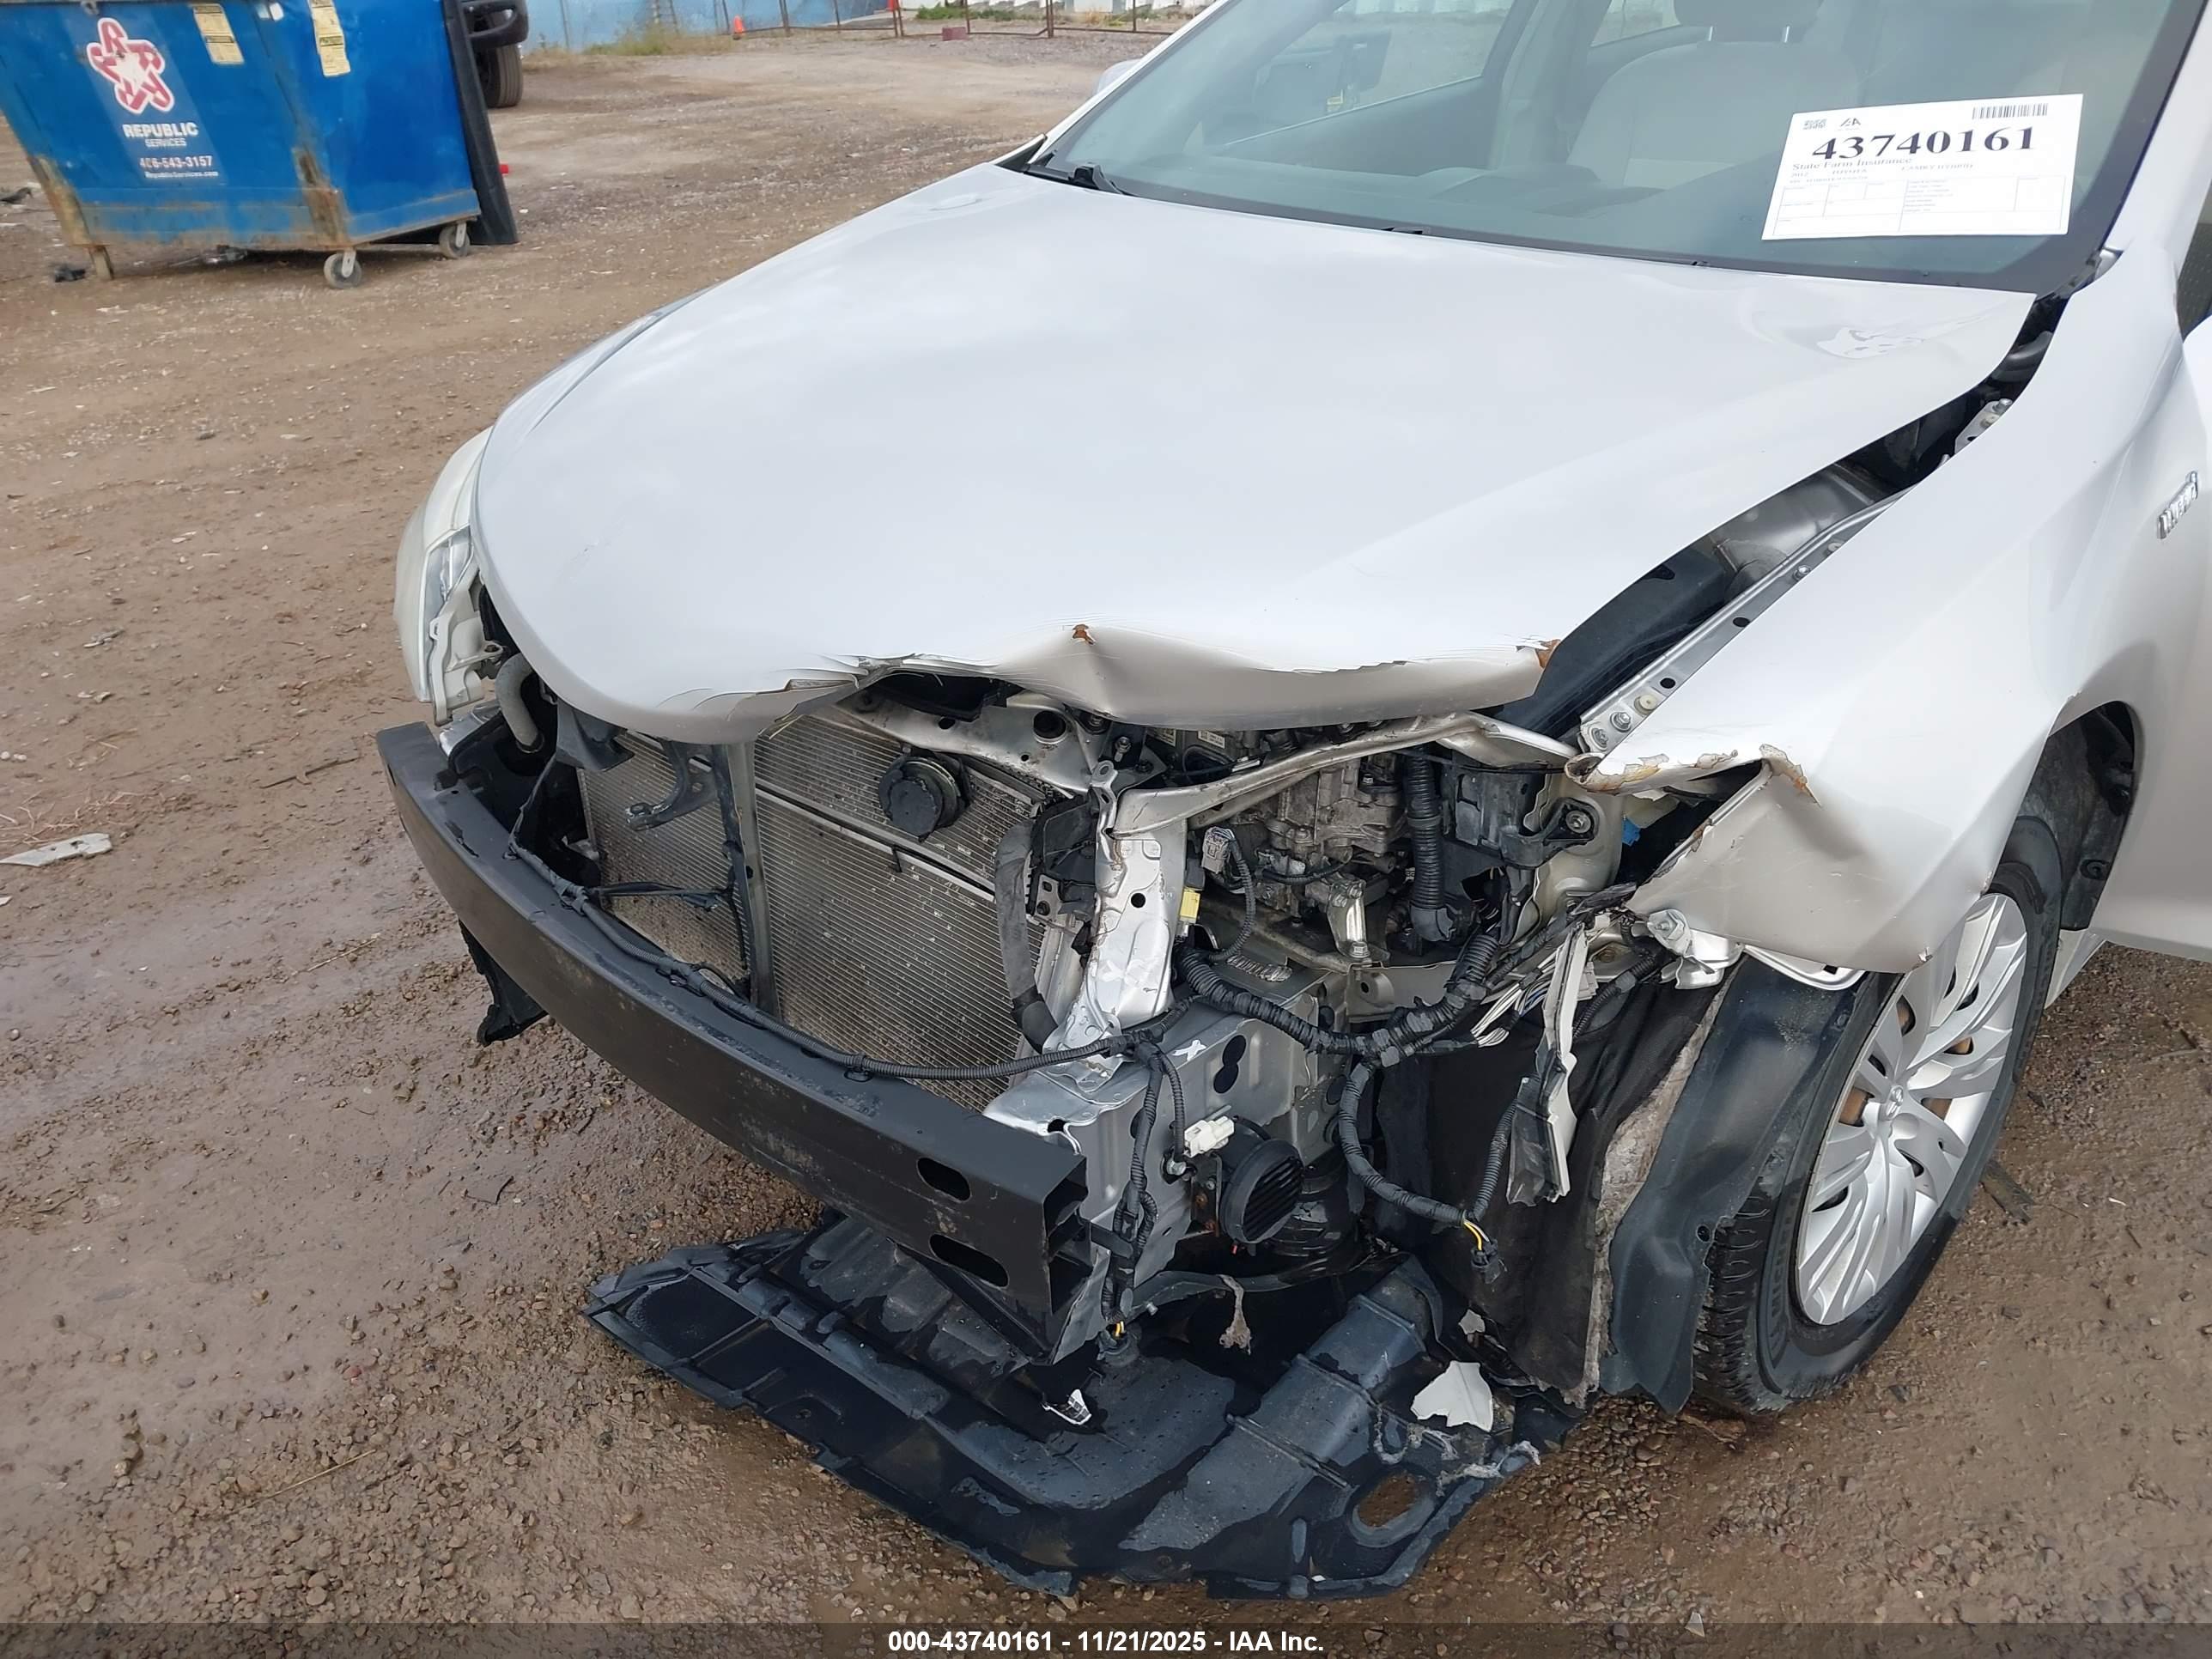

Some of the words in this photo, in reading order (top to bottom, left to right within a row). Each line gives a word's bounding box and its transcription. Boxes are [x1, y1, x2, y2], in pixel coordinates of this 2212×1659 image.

[122, 122, 198, 137] REPUBLIC
[145, 138, 186, 148] SERVICES
[1811, 126, 2035, 160] 43740161
[1856, 158, 1911, 167] Insurance
